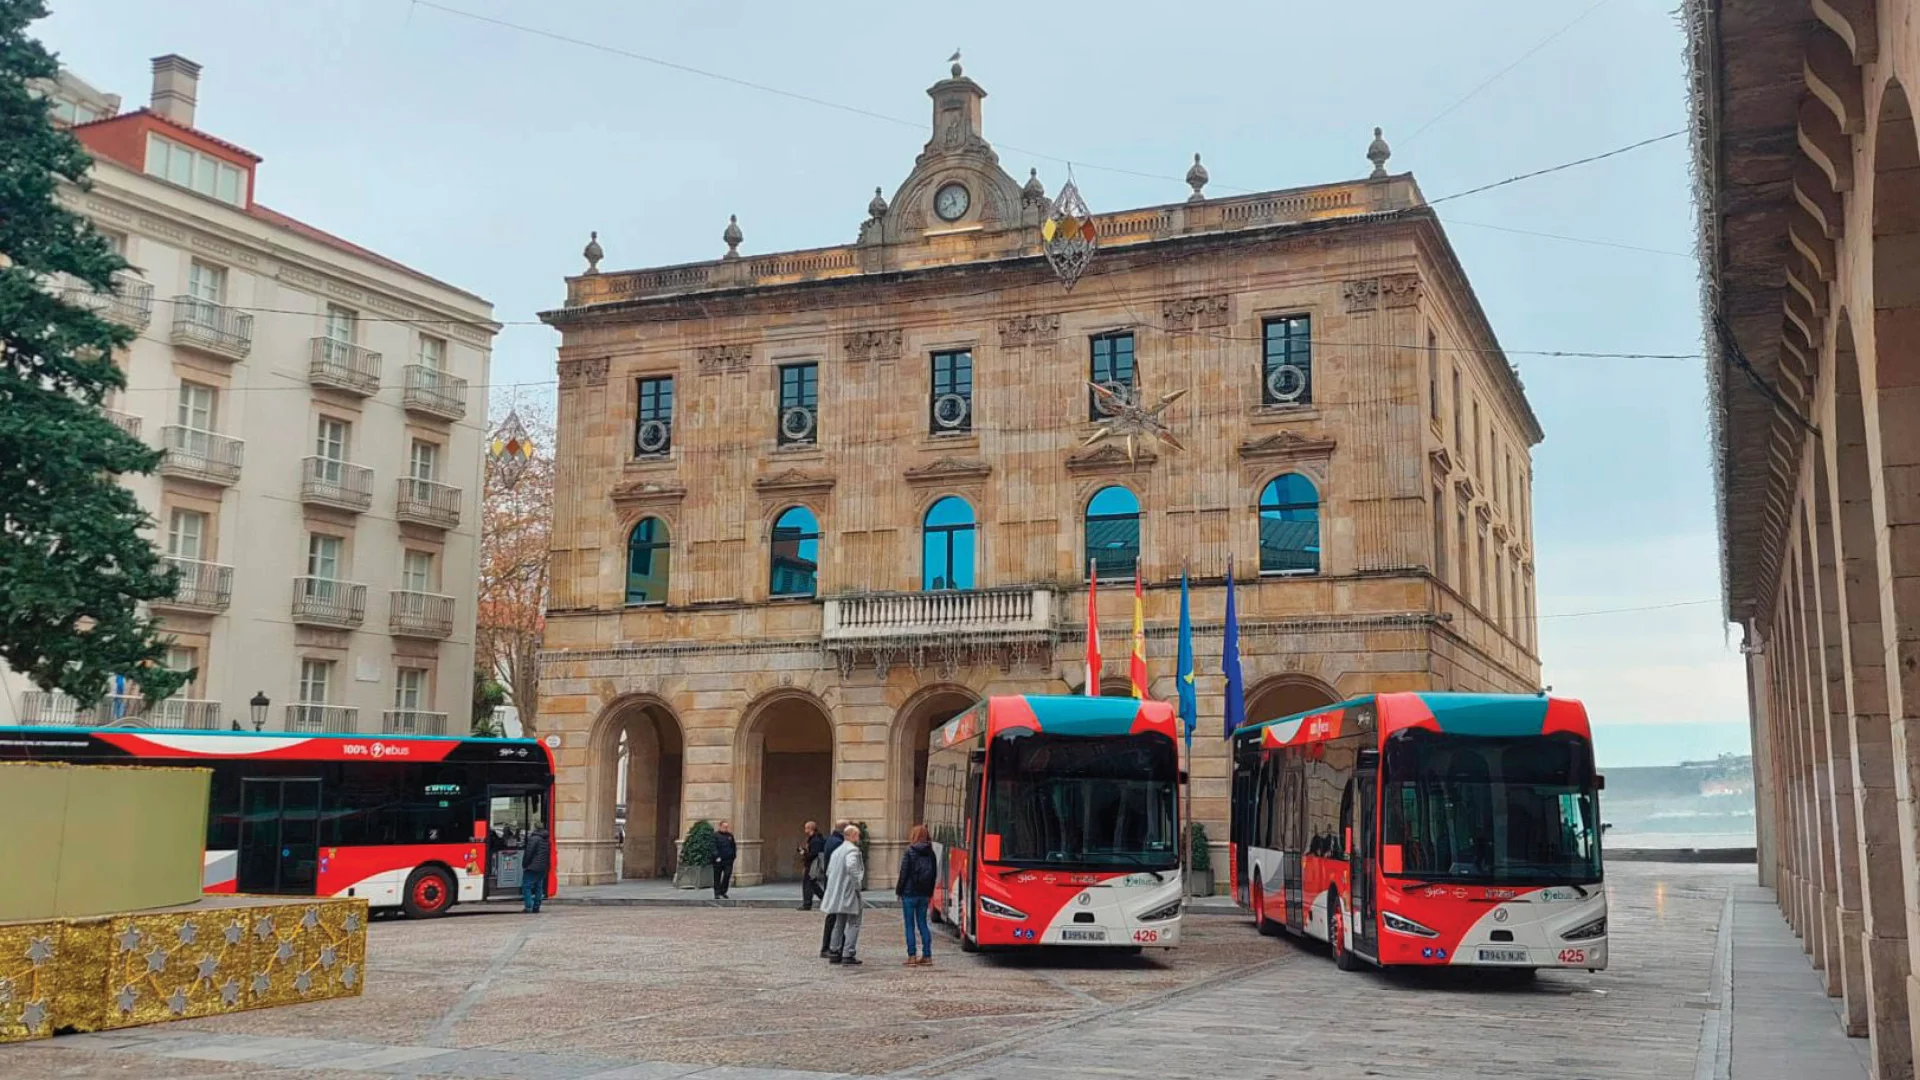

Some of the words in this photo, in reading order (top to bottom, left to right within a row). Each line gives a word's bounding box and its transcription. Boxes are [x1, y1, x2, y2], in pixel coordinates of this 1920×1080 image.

[343, 744, 369, 755] 100%
[385, 745, 410, 756] ebus
[1133, 930, 1157, 942] 426
[1558, 949, 1585, 963] 425
